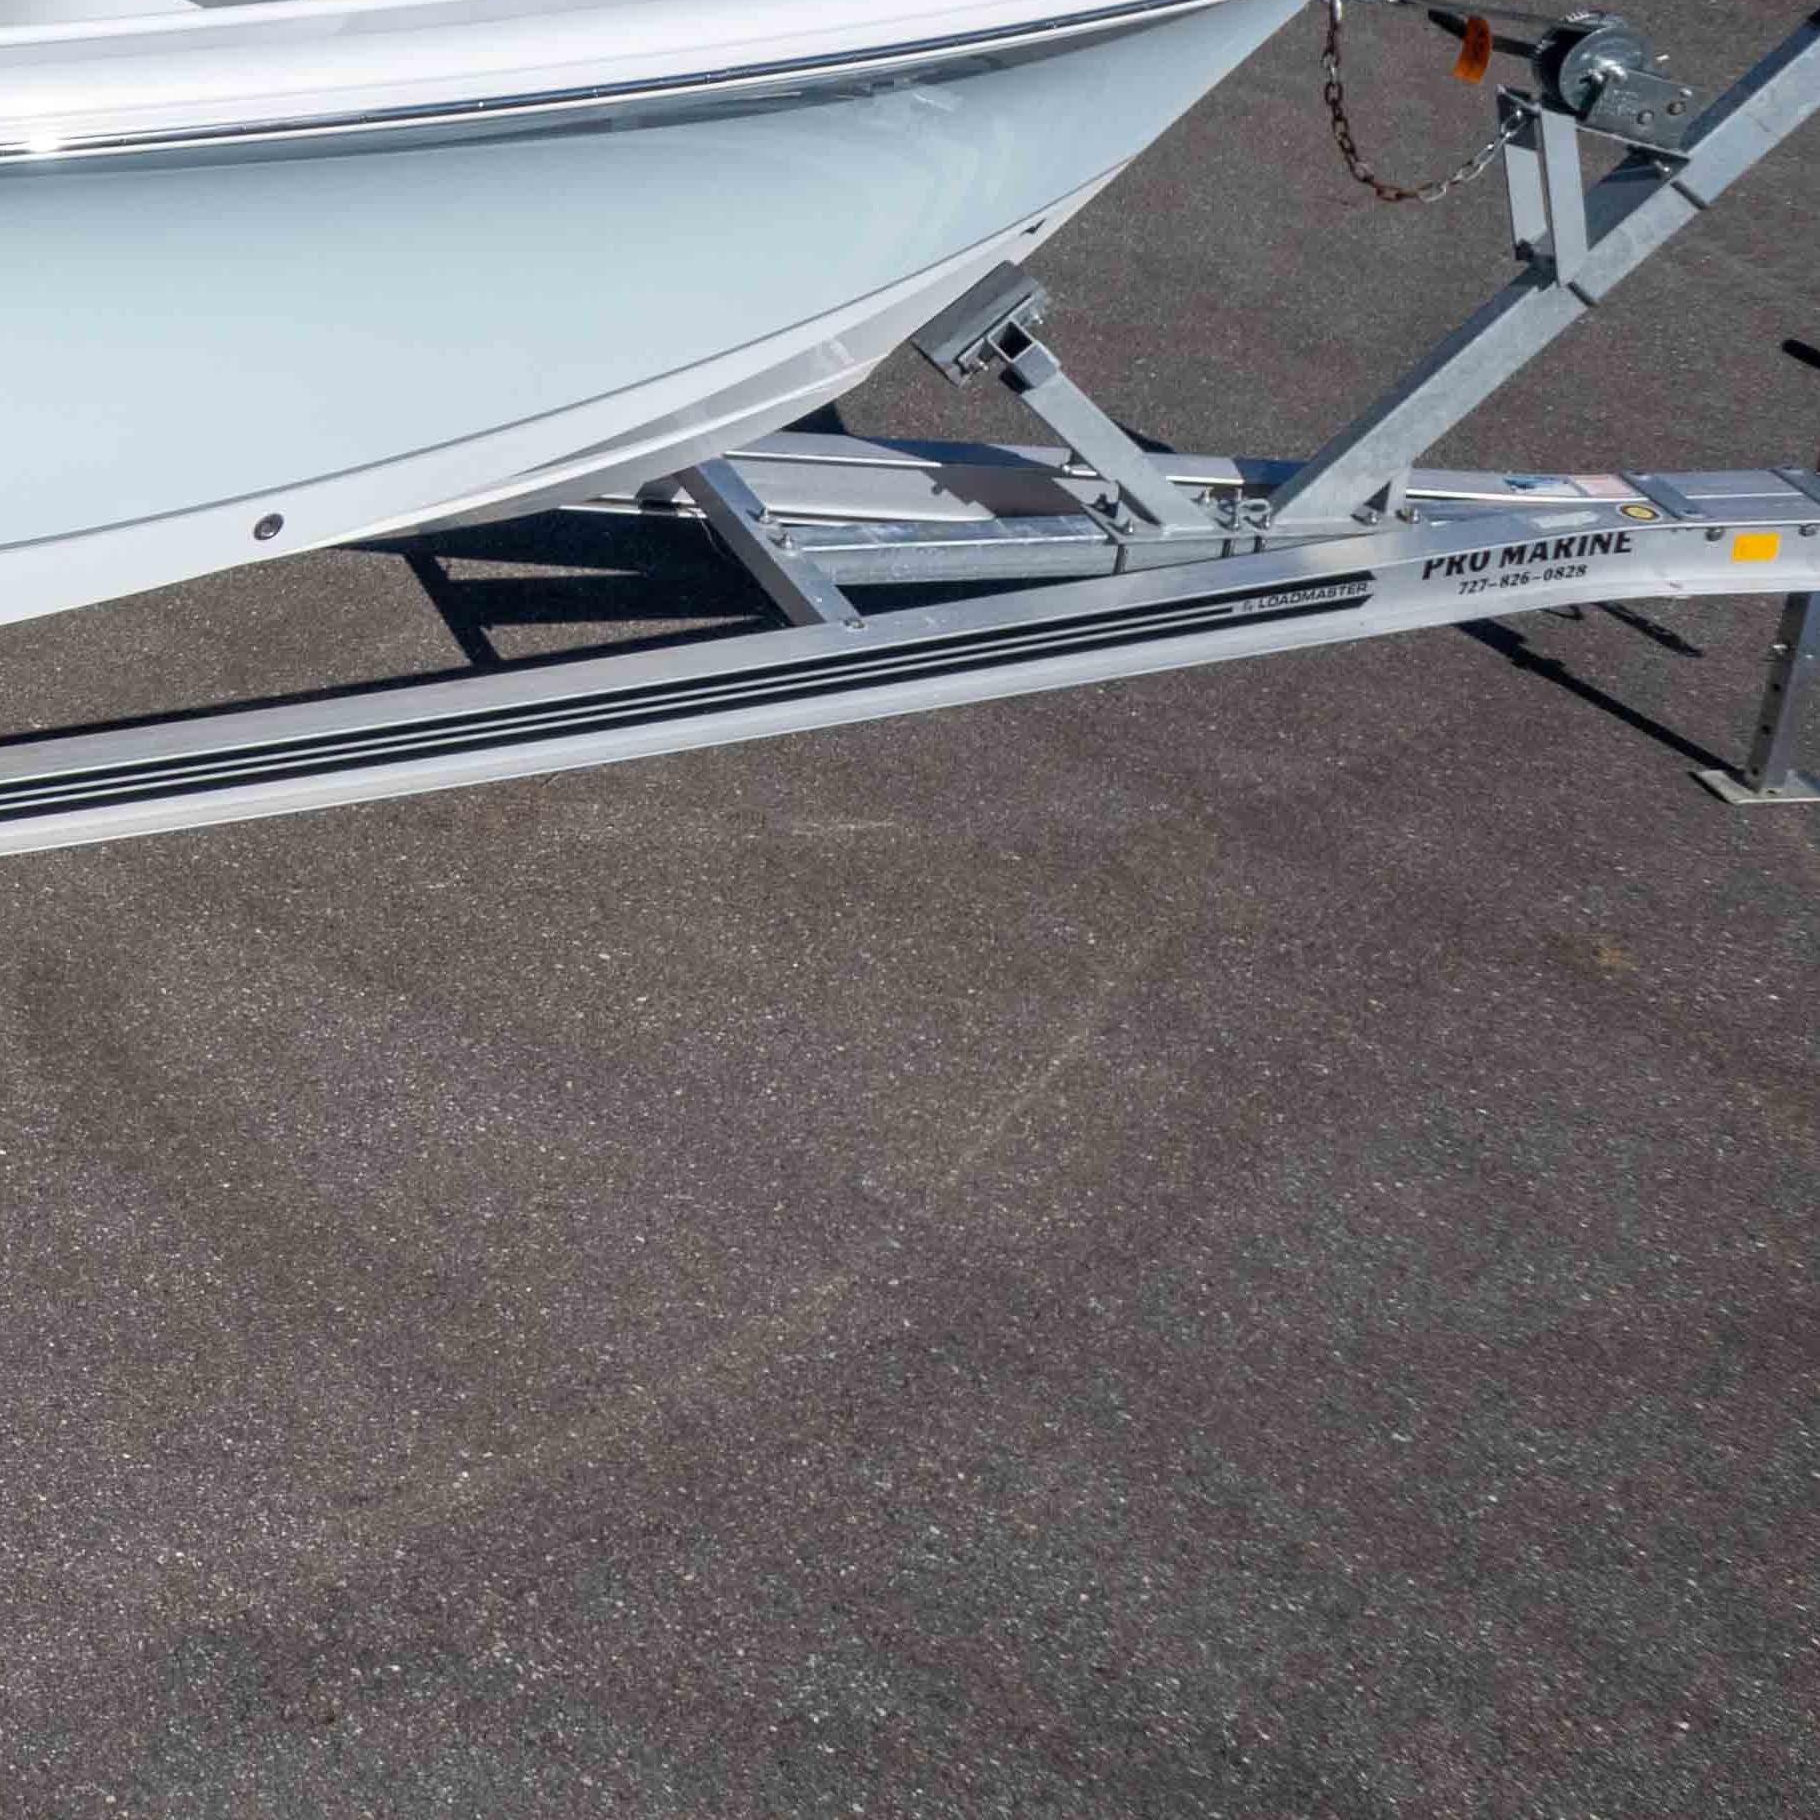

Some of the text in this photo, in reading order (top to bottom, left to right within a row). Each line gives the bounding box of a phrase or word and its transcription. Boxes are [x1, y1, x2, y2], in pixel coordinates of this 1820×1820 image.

[1421, 531, 1633, 580] PRO MARINE
[1458, 564, 1588, 595] 727-826-0828
[1257, 582, 1368, 609] LOADMASTER
